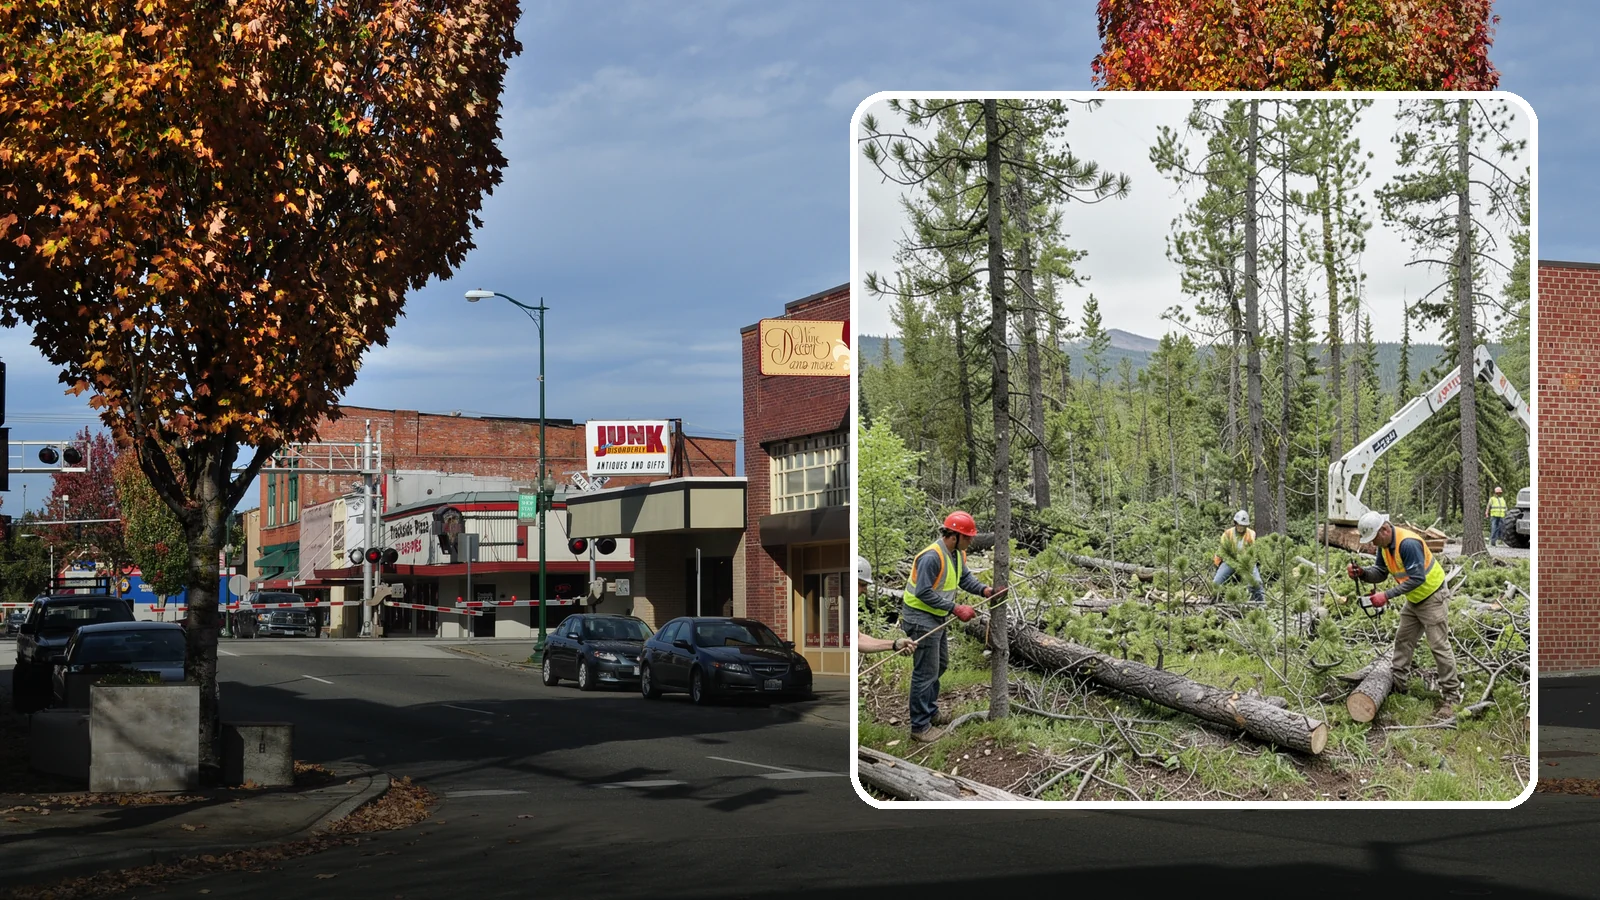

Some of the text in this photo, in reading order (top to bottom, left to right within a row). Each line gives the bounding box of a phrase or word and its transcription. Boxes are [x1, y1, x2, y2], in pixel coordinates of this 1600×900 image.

[595, 426, 666, 457] JUNK
[608, 446, 646, 454] DISORDERLY
[597, 460, 665, 470] ANTIQUES AND GIFTS
[573, 474, 588, 490] RAIL
[390, 520, 429, 539] Trackside Pizza
